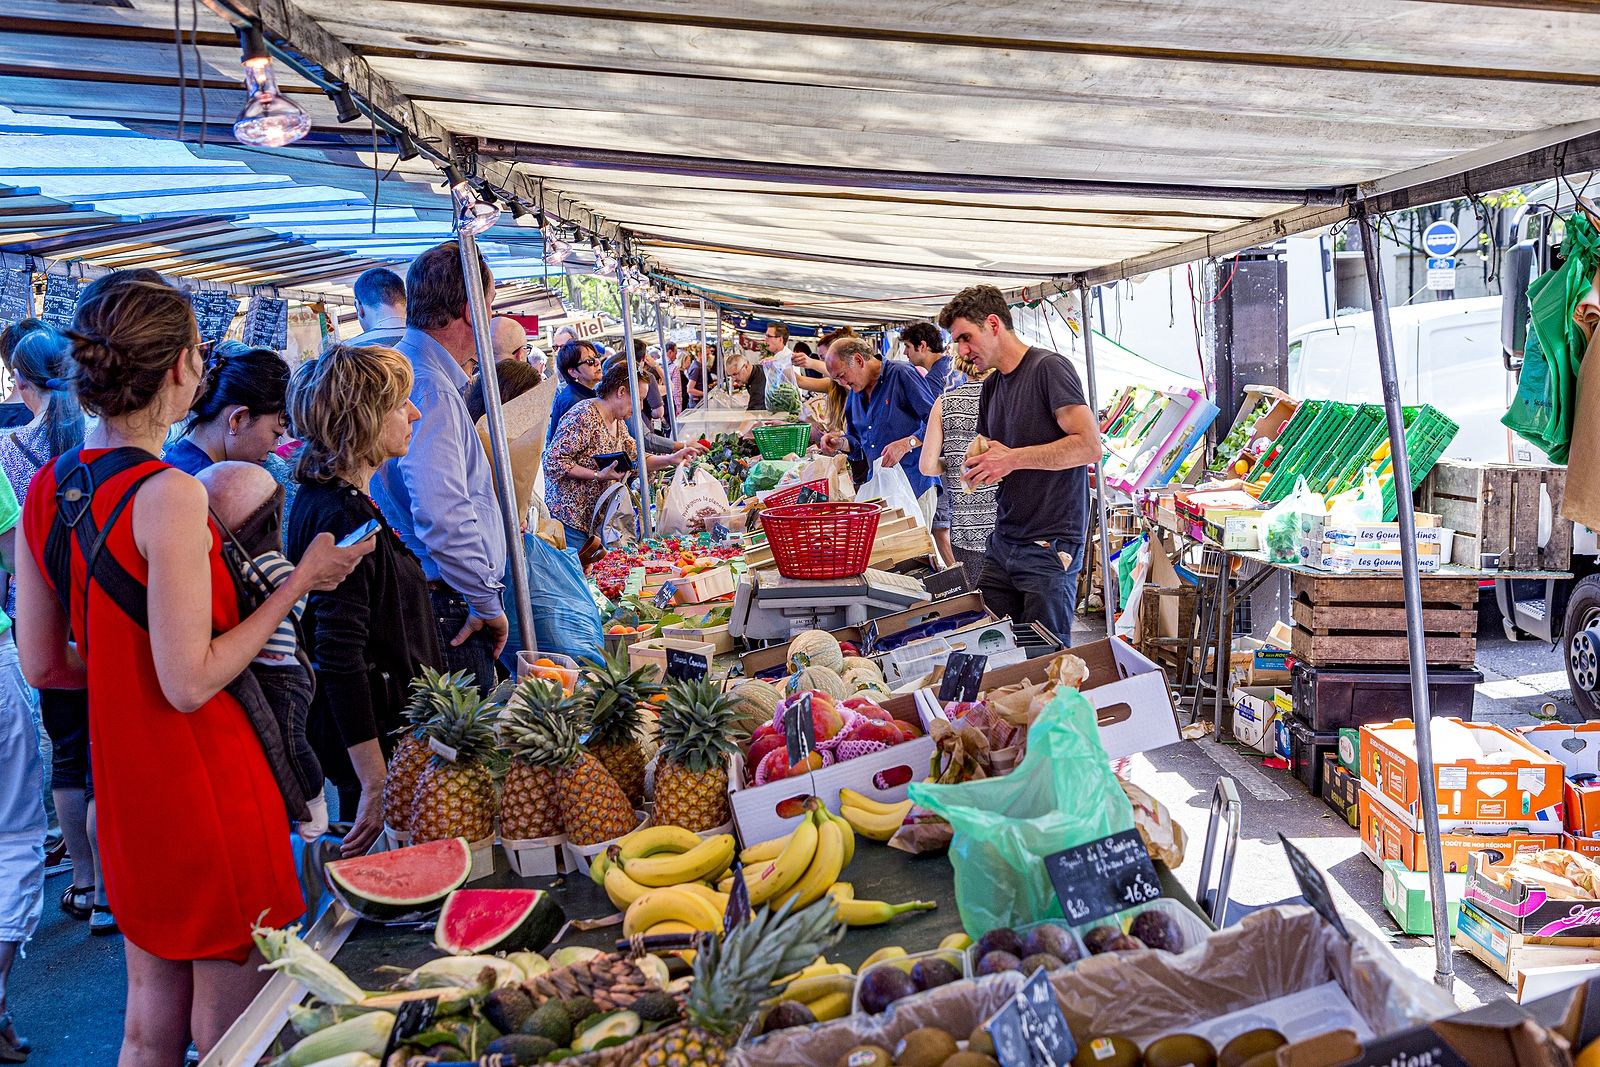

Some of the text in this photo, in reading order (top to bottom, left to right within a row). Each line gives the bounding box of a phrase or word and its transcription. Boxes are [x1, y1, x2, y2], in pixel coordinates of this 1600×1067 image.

[573, 317, 604, 338] Miel
[1360, 530, 1374, 539] Les
[1358, 557, 1371, 566] Les
